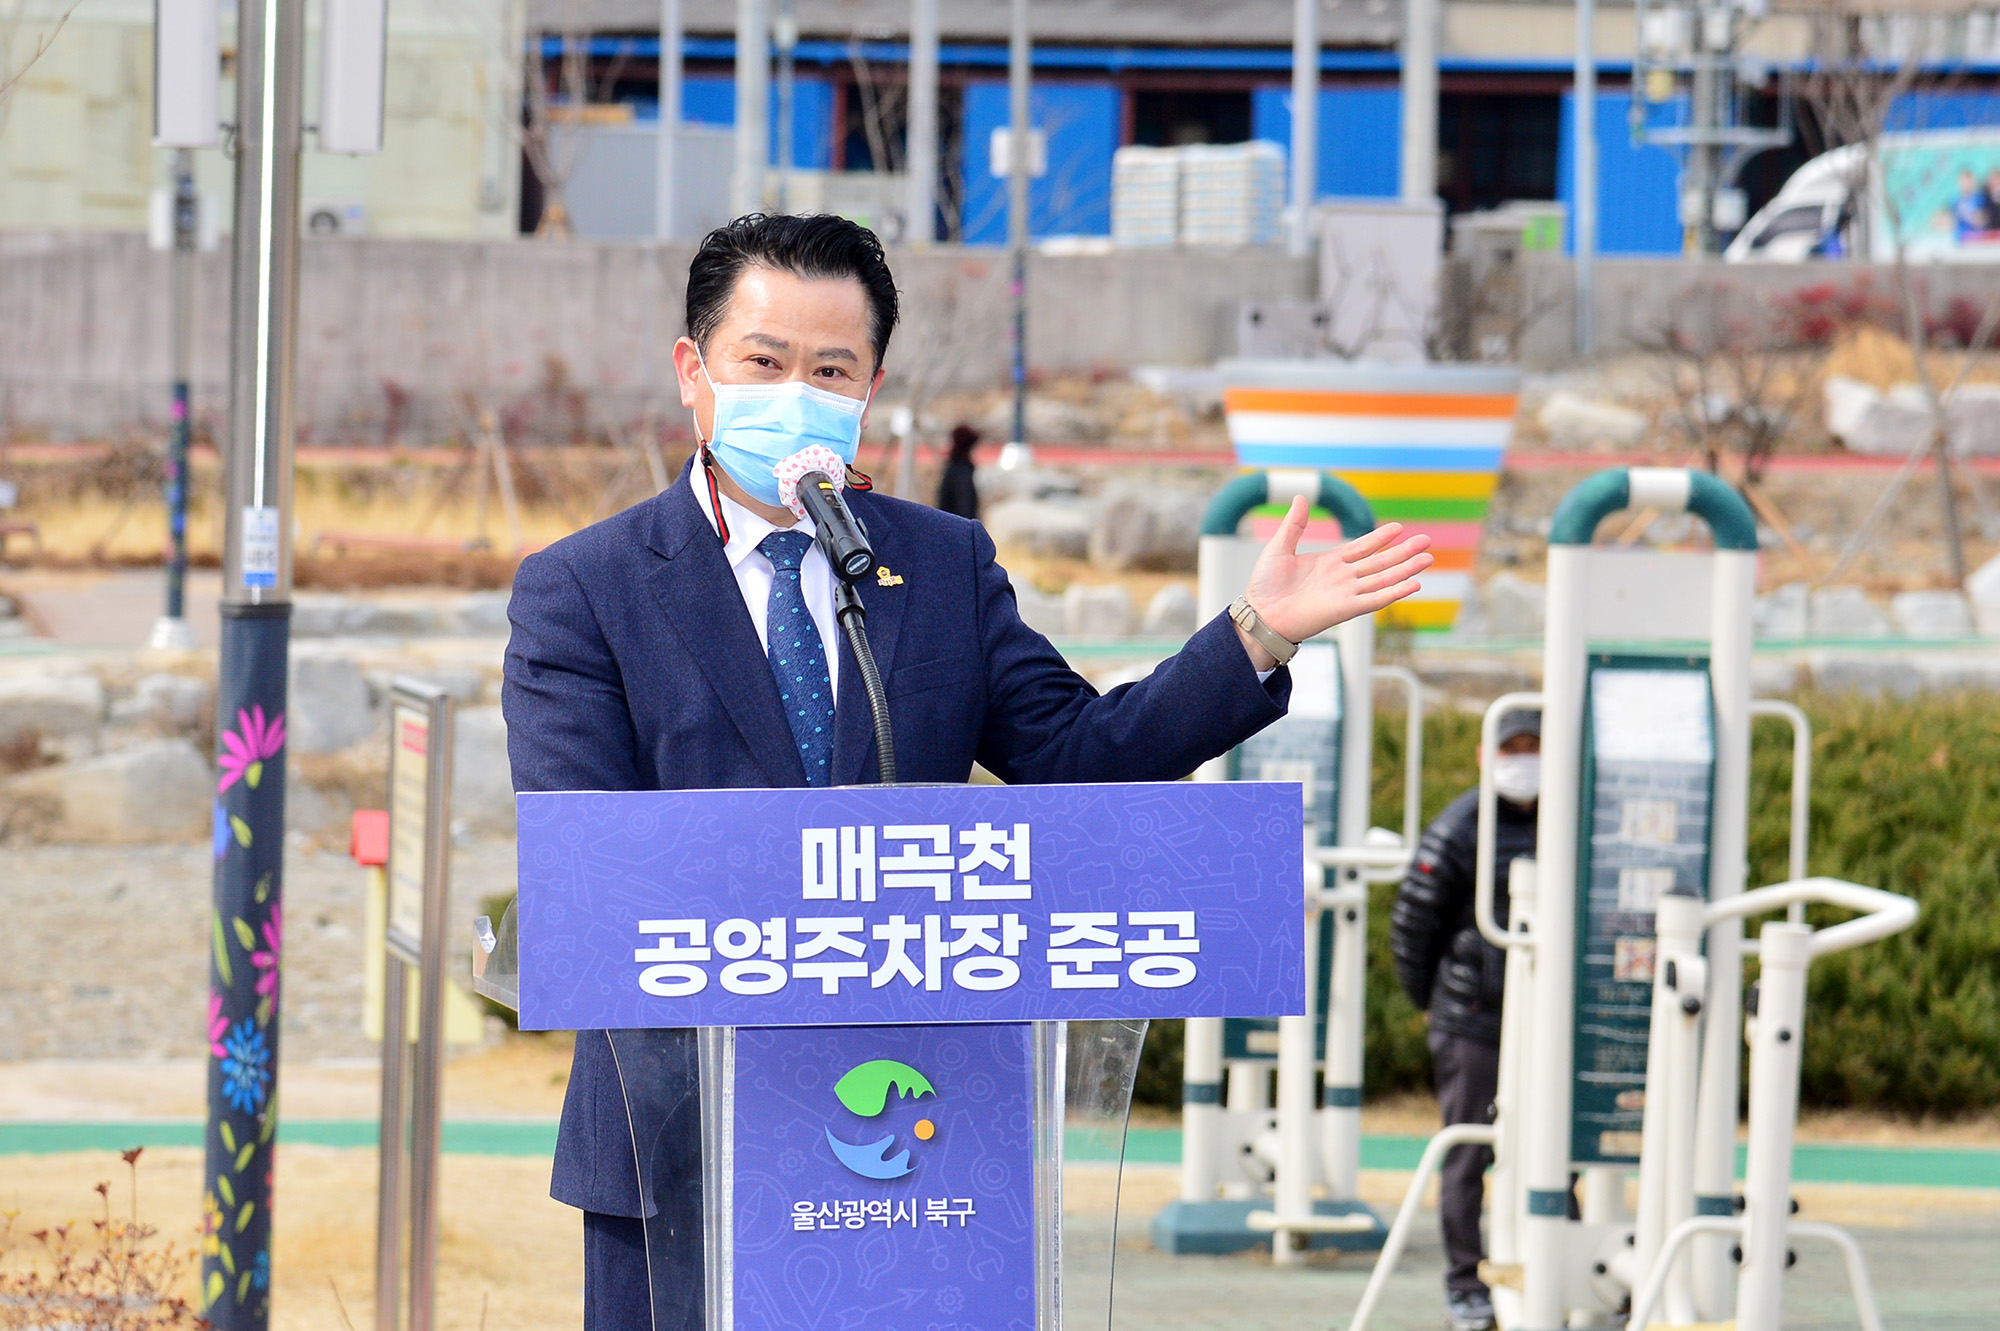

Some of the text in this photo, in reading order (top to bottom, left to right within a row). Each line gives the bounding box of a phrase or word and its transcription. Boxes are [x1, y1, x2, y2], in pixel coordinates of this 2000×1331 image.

[802, 822, 1032, 902] 매곡천
[634, 910, 1200, 998] 공영주차장 준공
[791, 1197, 976, 1231] 울산광역시 북구
